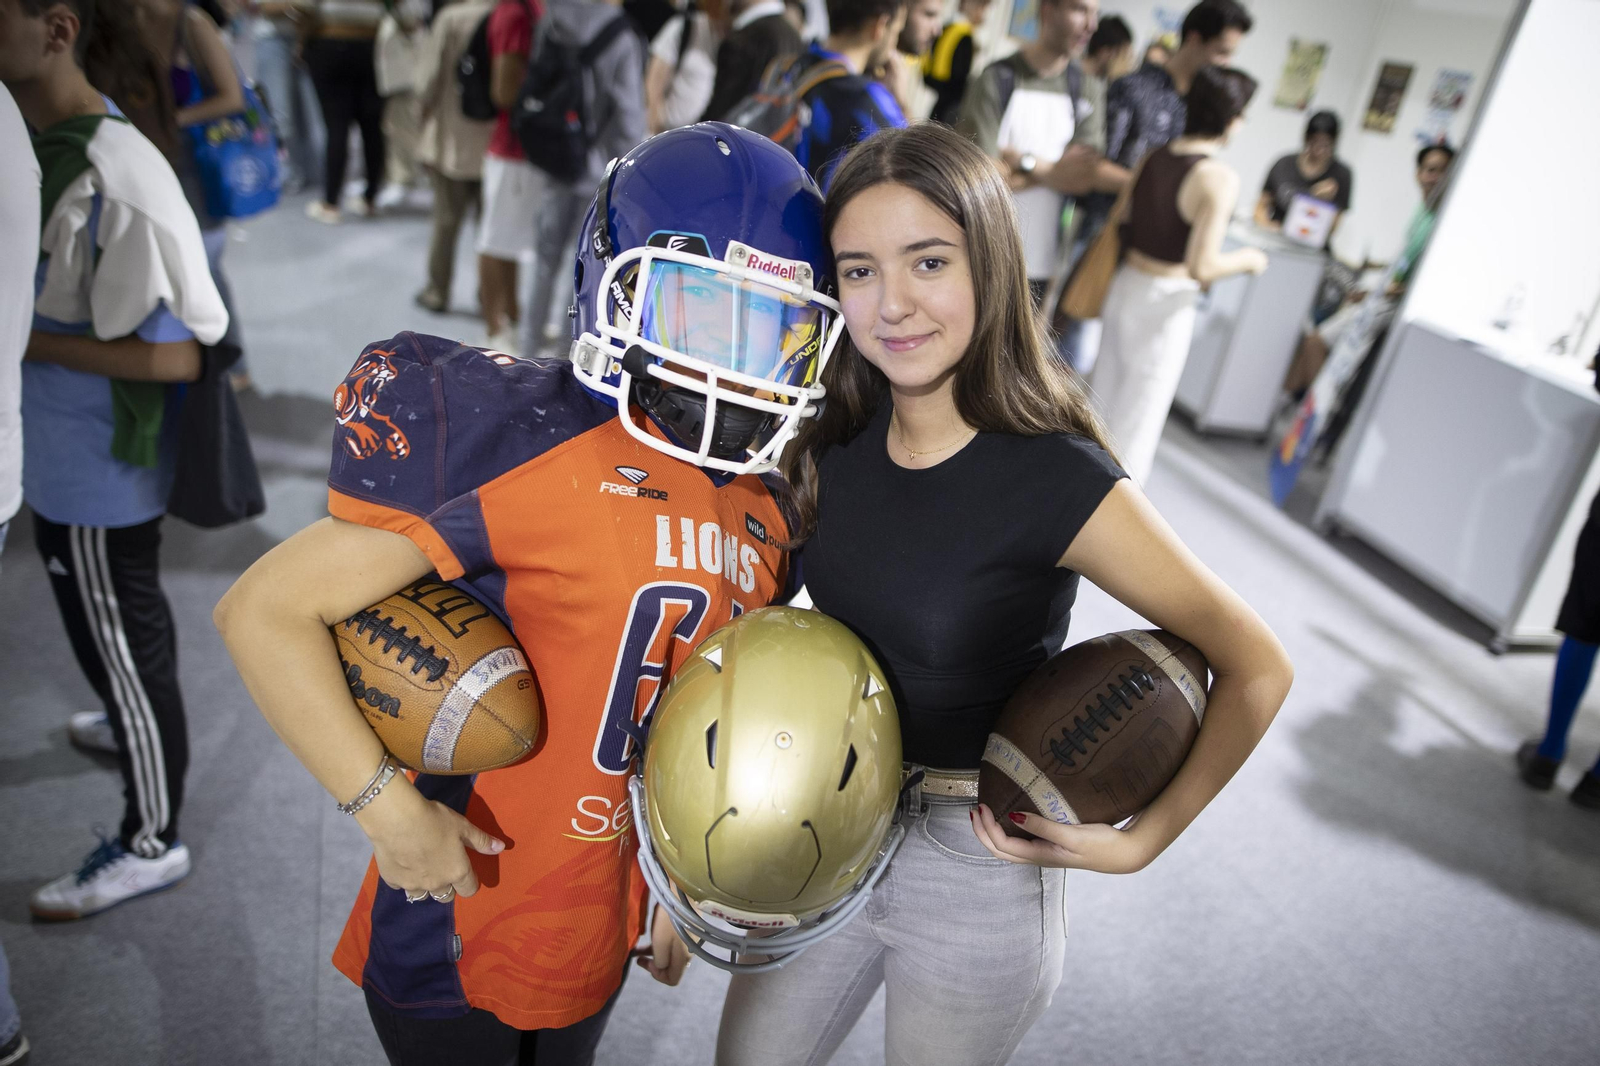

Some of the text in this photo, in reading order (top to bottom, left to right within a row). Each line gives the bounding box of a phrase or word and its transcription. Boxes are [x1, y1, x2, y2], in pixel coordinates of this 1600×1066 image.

[747, 253, 796, 281] Riddell
[747, 519, 764, 539] wild
[655, 514, 760, 593] LIONS
[338, 651, 401, 719] lson
[571, 795, 633, 835] Se
